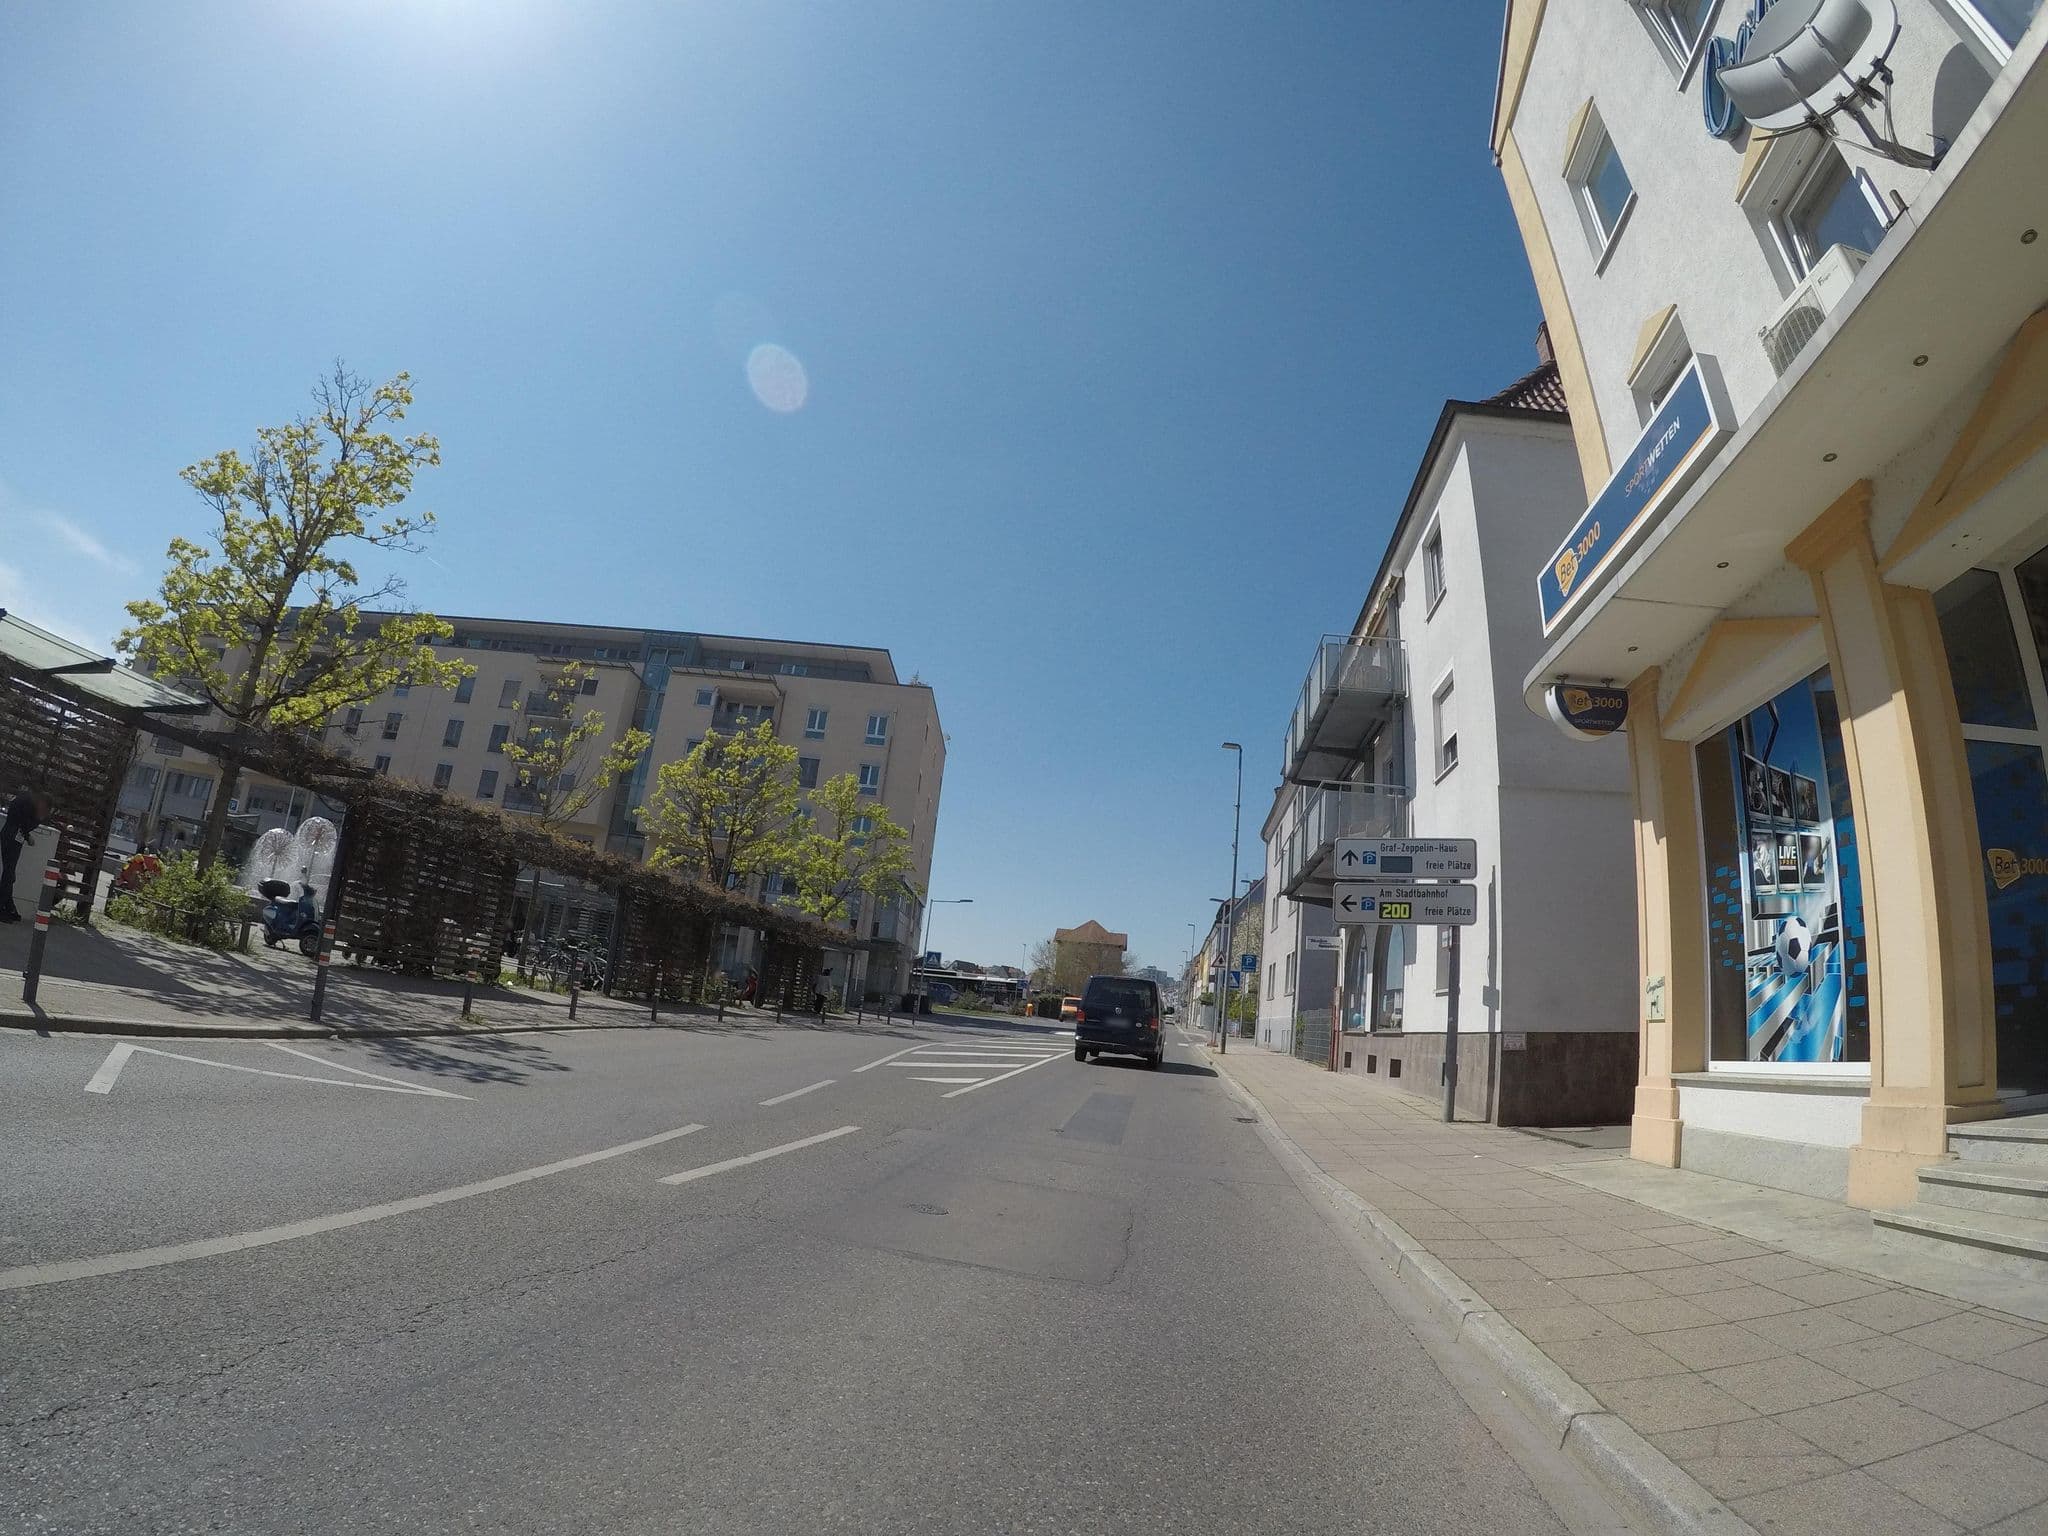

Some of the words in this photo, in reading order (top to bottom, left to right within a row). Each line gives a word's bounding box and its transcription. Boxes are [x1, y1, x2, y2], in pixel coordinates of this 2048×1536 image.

[1625, 415, 1681, 498] SPORTWETTEN
[1577, 520, 1601, 563] 3000
[1592, 697, 1623, 709] 3000
[1380, 843, 1458, 853] Graf-Zeppelin-Haus
[1779, 845, 1797, 860] LIVE
[1425, 860, 1445, 870] freie
[1447, 860, 1472, 870] Plätze
[1379, 888, 1393, 898] Am
[1395, 888, 1449, 899] Stadtbahnhof
[1382, 903, 1410, 919] 200
[1425, 906, 1444, 916] freie
[1447, 906, 1472, 916] Plätze
